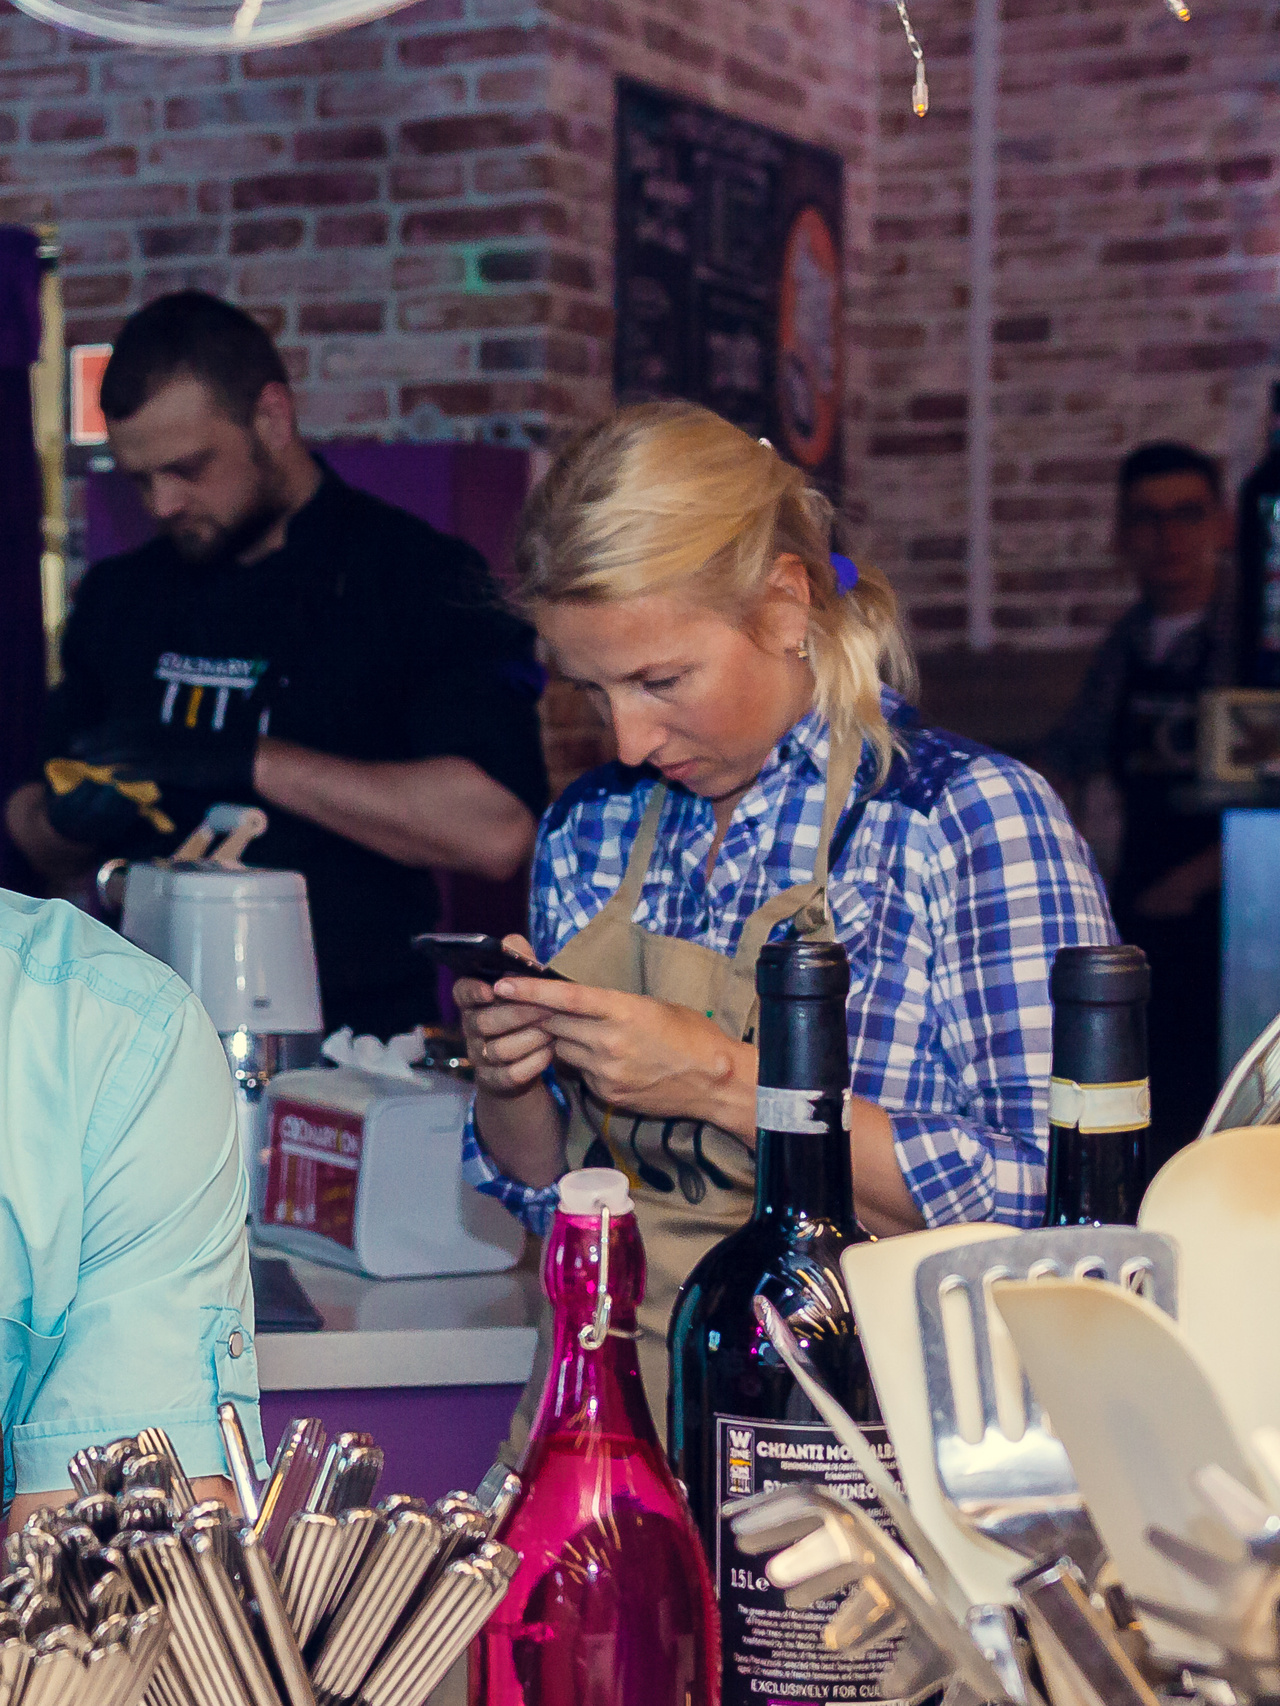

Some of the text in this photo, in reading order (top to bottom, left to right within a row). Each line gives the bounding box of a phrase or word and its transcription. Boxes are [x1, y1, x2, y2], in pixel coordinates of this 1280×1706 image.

[756, 1440, 896, 1461] CHIANTI MOALB
[750, 1678, 831, 1699] EXCLUSIVELY
[832, 1684, 858, 1698] FOR
